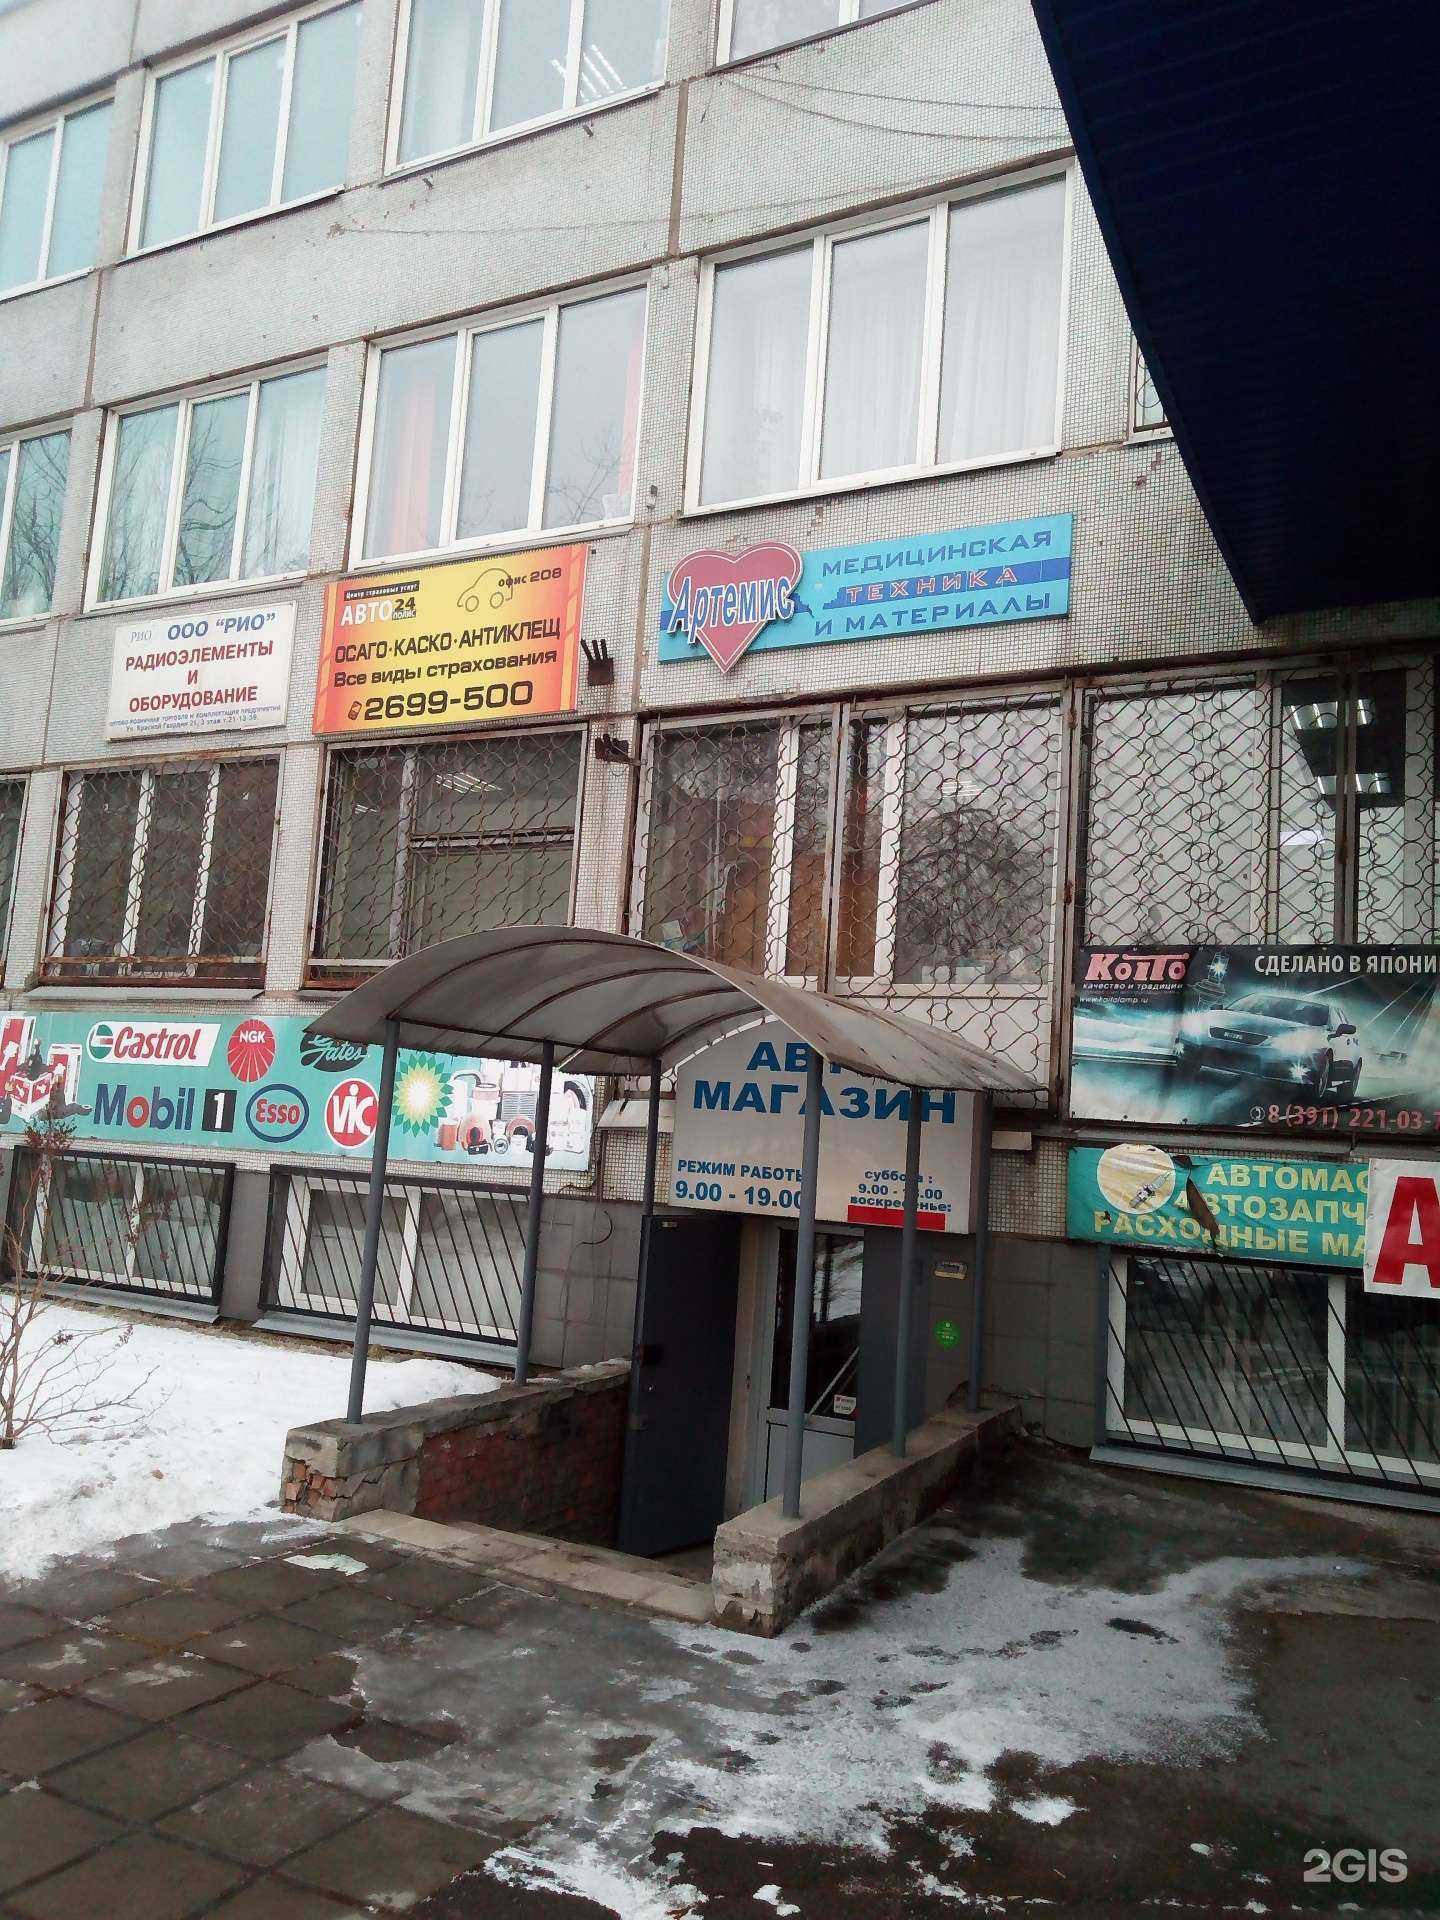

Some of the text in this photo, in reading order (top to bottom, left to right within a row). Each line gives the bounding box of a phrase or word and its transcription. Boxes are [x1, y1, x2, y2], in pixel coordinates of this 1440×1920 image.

[822, 529, 1053, 577] МЕДИЦИНСКАЯ
[497, 567, 562, 588] офис 208
[845, 567, 1018, 605] ТЕХНИКА
[341, 596, 416, 626] АВТО 24
[667, 575, 794, 645] Артемис
[814, 592, 1051, 637] И МАТЕРИАЛЫ
[167, 620, 209, 641] ООО
[125, 640, 274, 671] РАДИОЭЛЕМЕНТЫ
[334, 650, 558, 688] Все виды страхования
[187, 669, 199, 685] И
[129, 686, 258, 713] ОБОРУДОВАНИЕ
[364, 681, 533, 721] 2699-500
[1254, 955, 1440, 976] СДЕЛАНО В ЯПОНИ
[1082, 982, 1184, 992] качество и традиции
[114, 1026, 202, 1061] Castrol
[239, 1030, 266, 1044] NGK
[93, 1084, 195, 1130] Mobil
[255, 1098, 301, 1125] Esso
[1267, 1103, 1280, 1124] 8
[1285, 1103, 1340, 1129] (391)
[677, 1159, 736, 1177] РЕЖИМ
[675, 1180, 722, 1201] 9.00
[858, 1183, 889, 1196] 9.00
